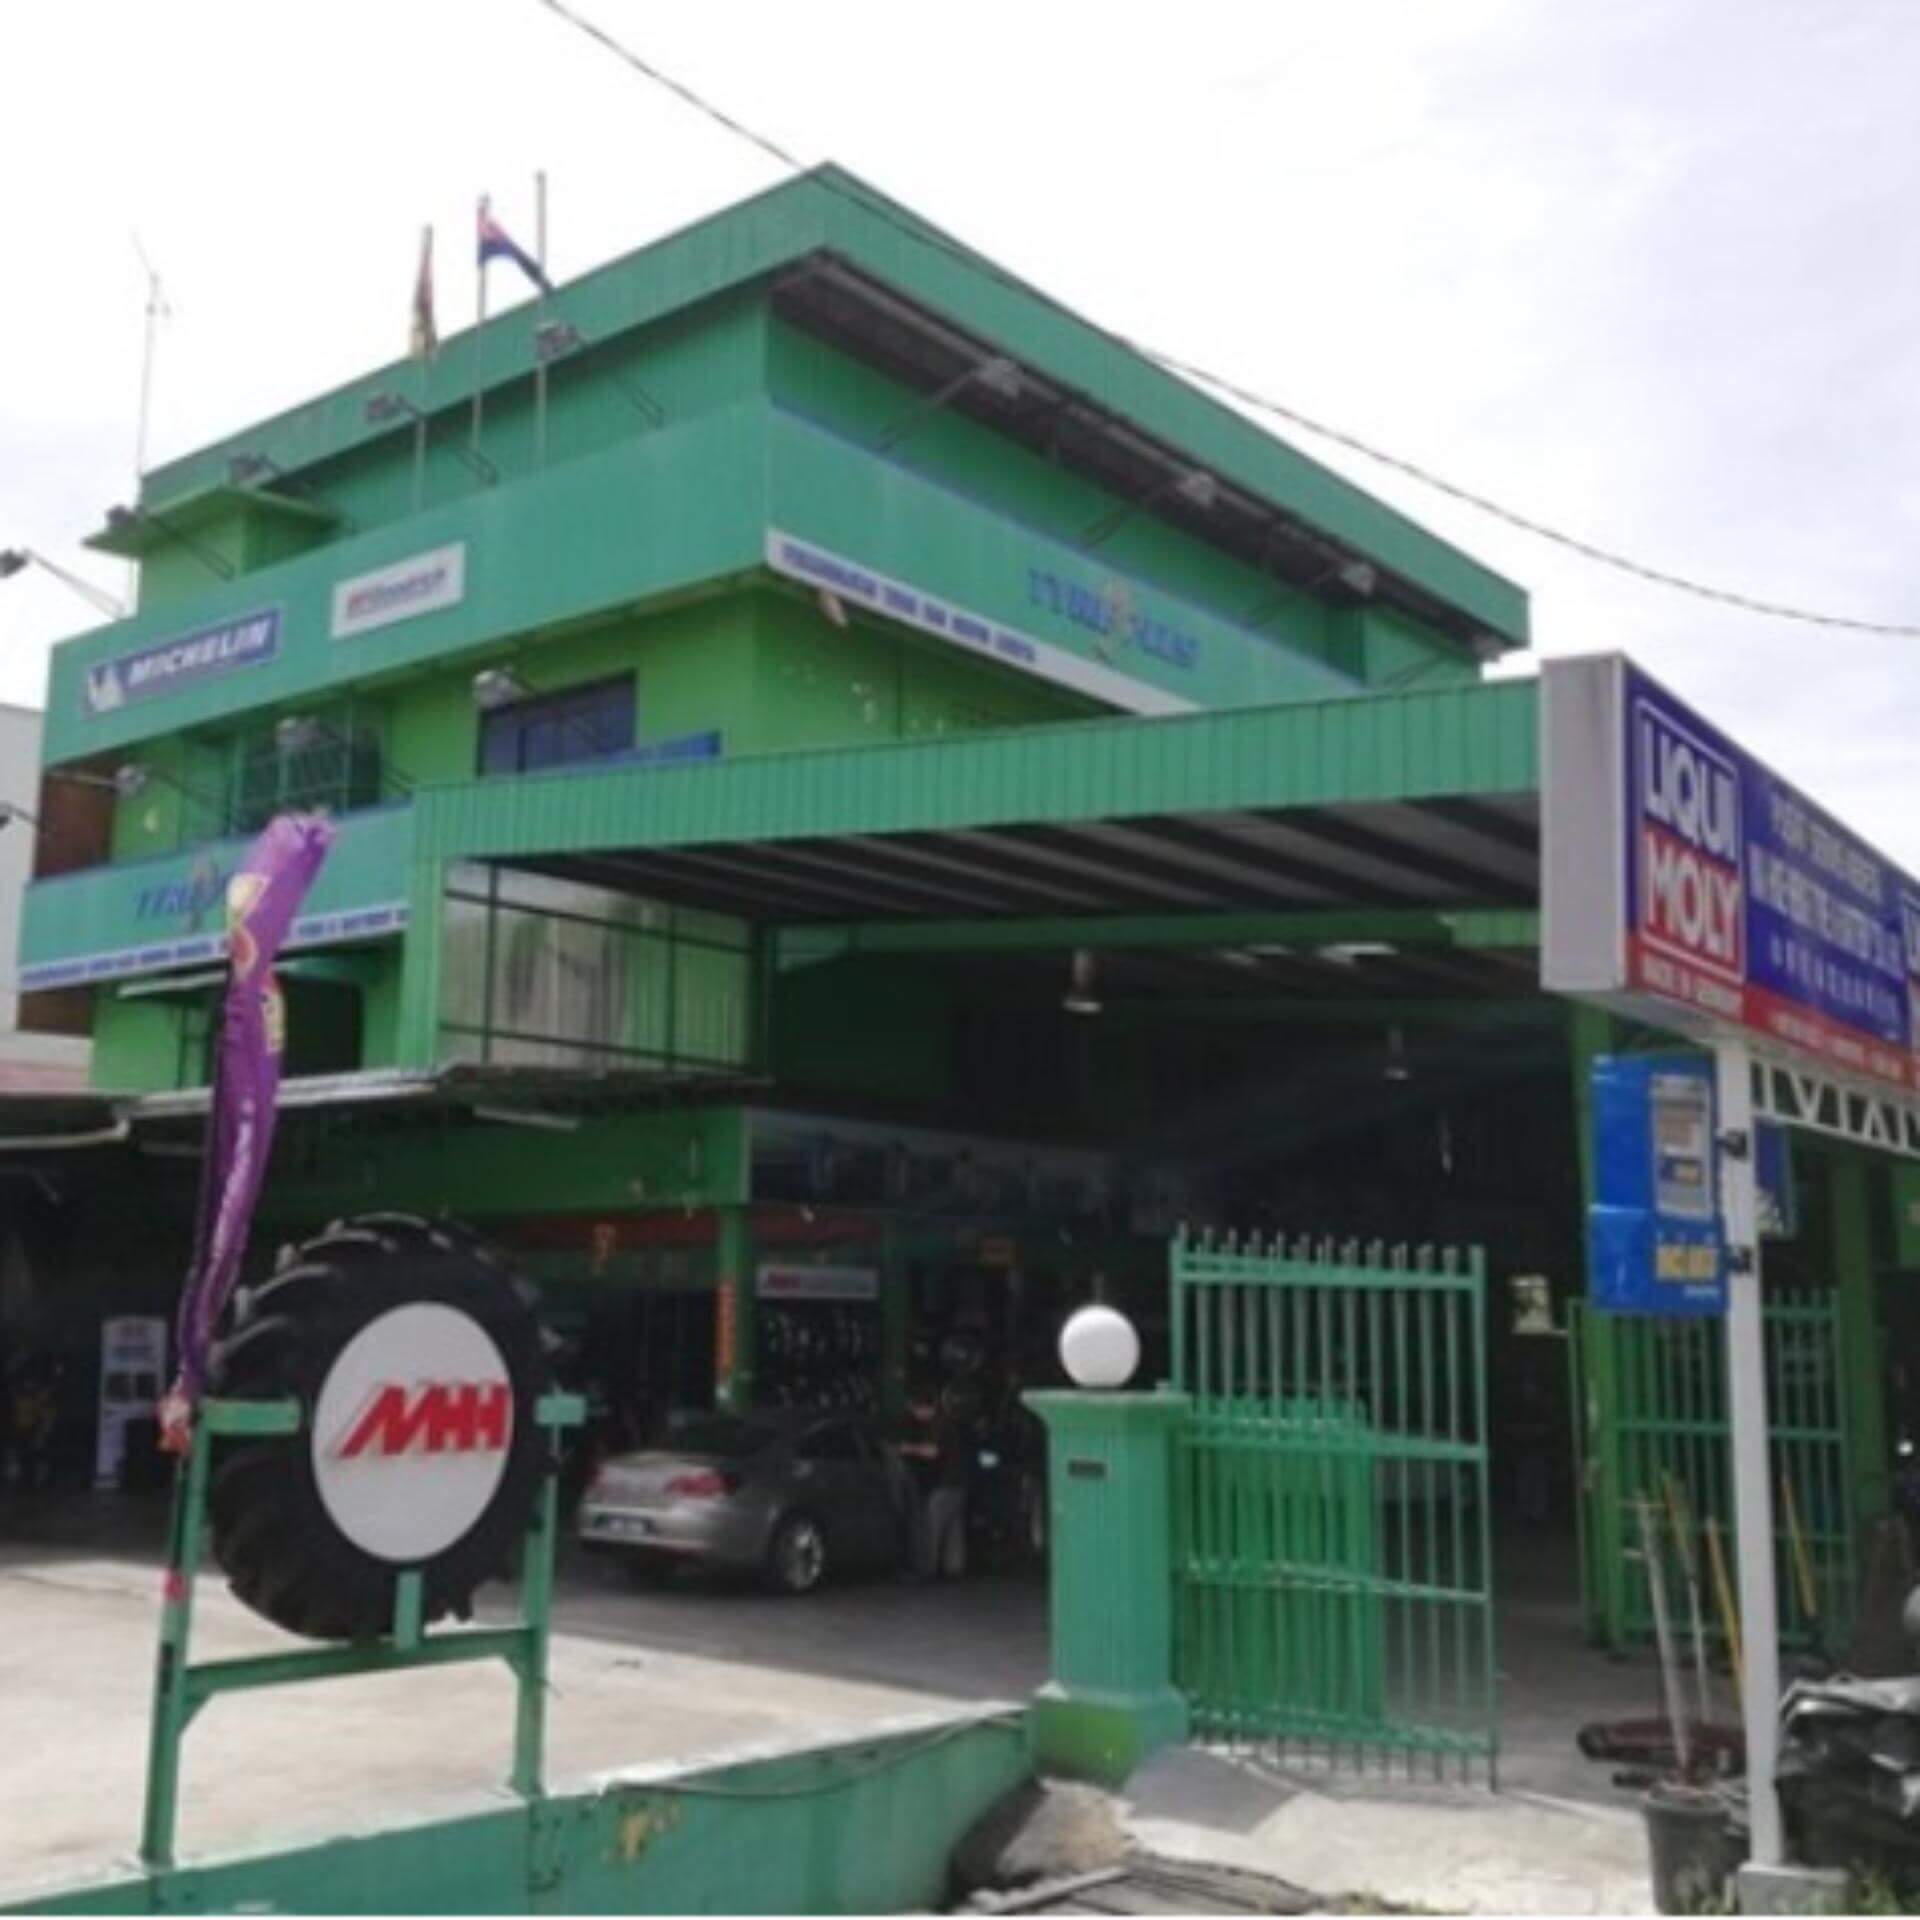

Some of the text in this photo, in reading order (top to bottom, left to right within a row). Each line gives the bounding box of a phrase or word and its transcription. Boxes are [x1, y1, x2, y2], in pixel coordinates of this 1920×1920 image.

[127, 618, 272, 687] MICHELIN
[1641, 715, 1738, 861] LIQUI
[1644, 828, 1742, 972] MOLY
